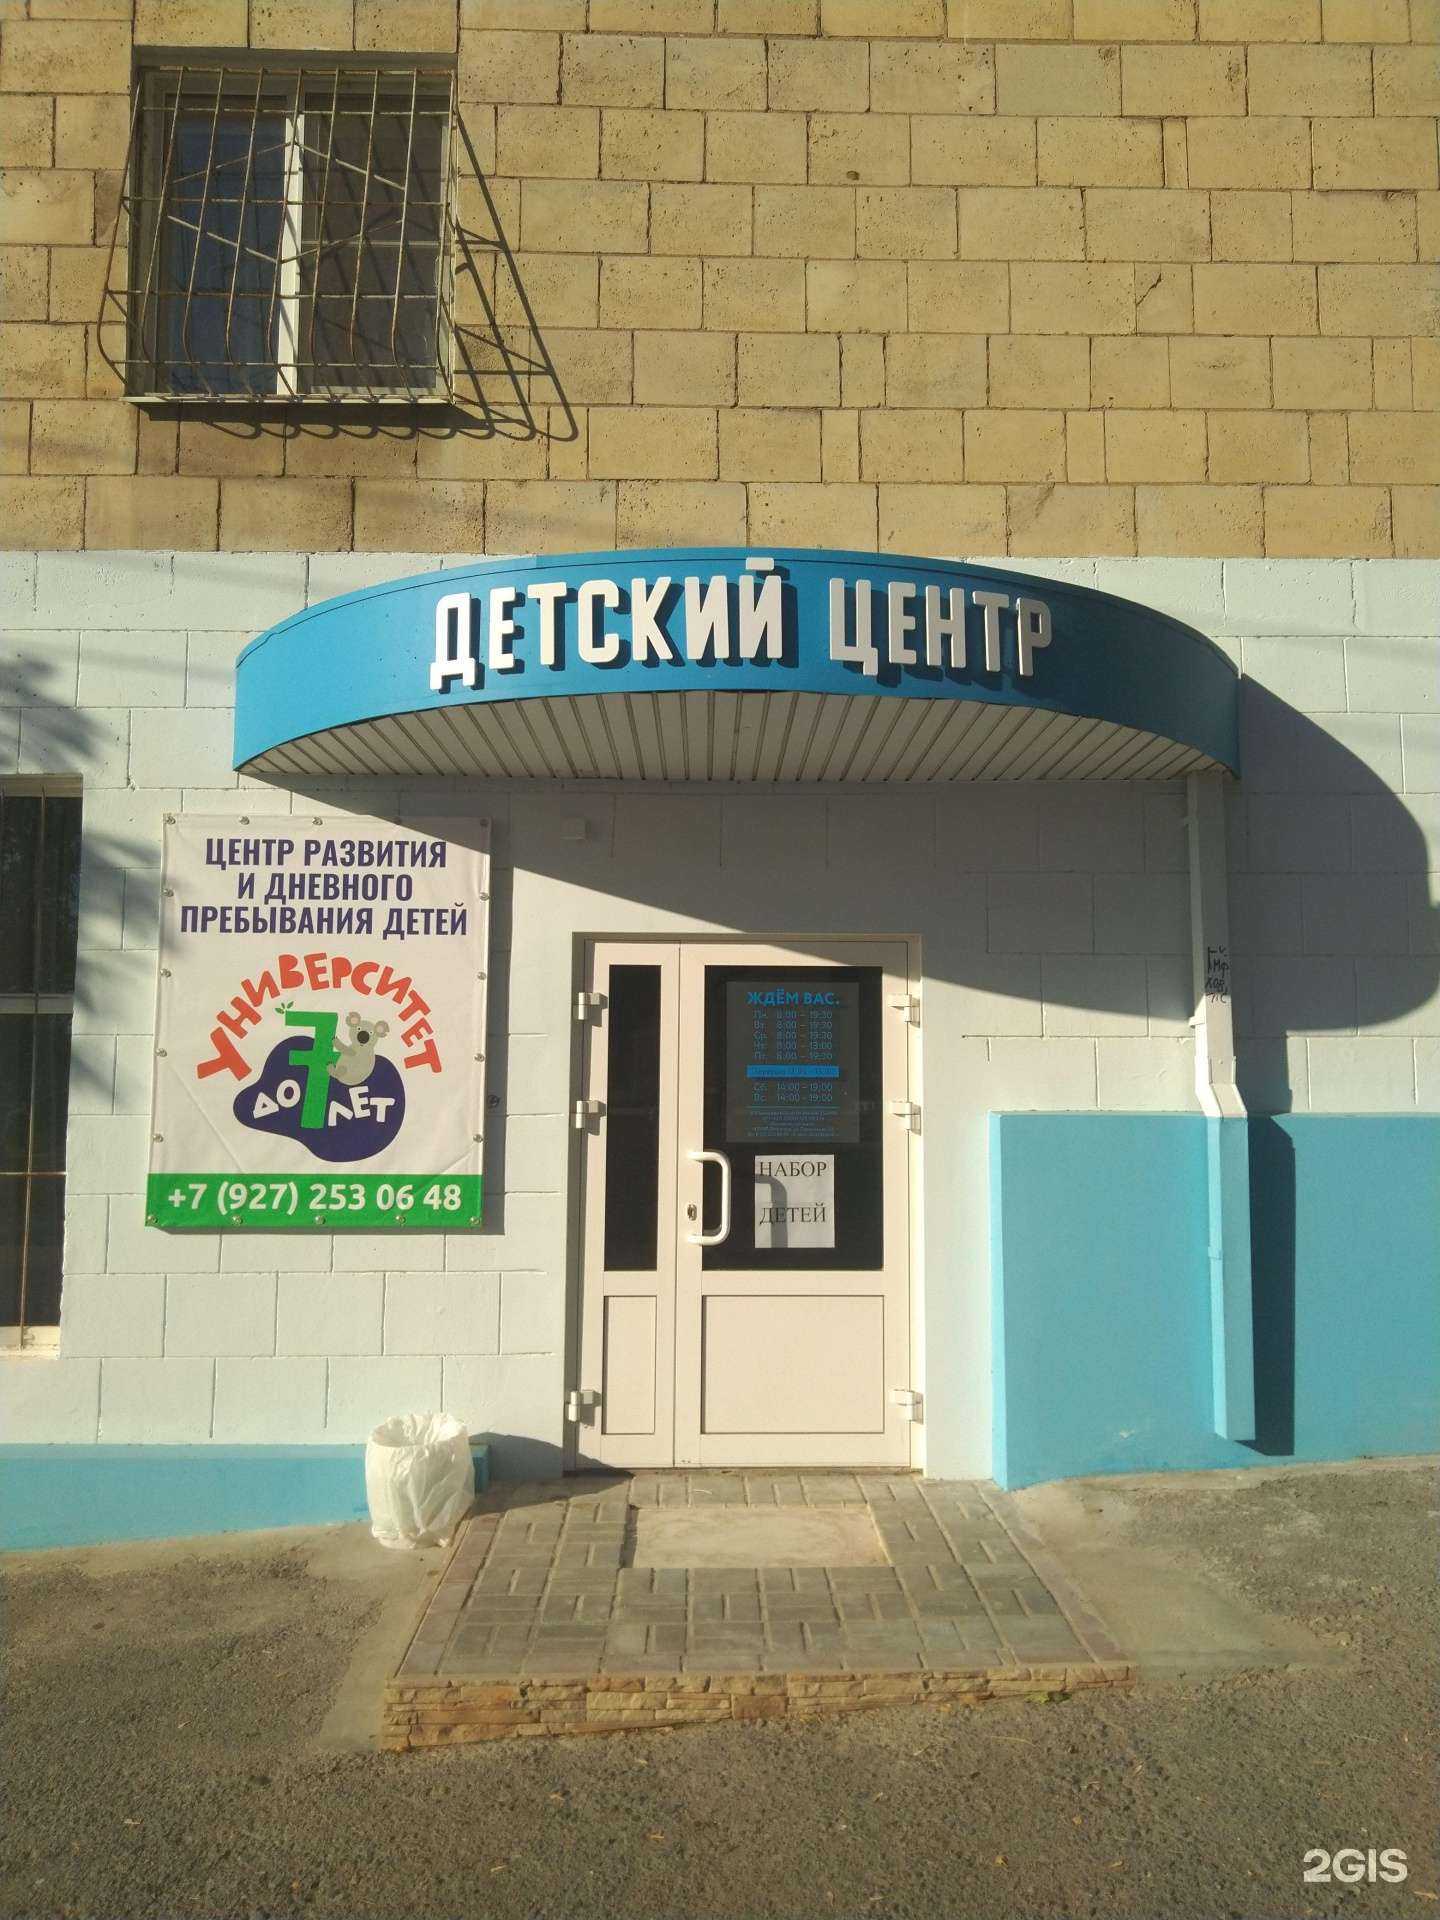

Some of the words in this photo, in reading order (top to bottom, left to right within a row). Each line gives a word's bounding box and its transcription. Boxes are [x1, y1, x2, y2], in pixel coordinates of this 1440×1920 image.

[429, 556, 783, 690] ДЕТСКИЙ
[829, 577, 1053, 677] ЦЕНТР
[205, 838, 295, 871] ЦЕНТР
[304, 839, 447, 868] РАЗВИТИЯ
[237, 872, 255, 900] И
[263, 872, 413, 906] ДНЕВНОГО
[180, 905, 373, 936] ПРЕБЫВАНИЯ
[382, 902, 468, 941] ДЕТЕЙ
[747, 988, 799, 1006] ЖДЁМ
[196, 951, 443, 1082] УНИВЕРСИТЕТ
[252, 1079, 301, 1119] ДО
[284, 1010, 341, 1130] 7
[327, 1085, 396, 1127] ЛЕТ
[760, 1161, 827, 1177] НАБОР
[168, 1183, 207, 1210] +7
[217, 1181, 299, 1215] (927)
[309, 1183, 366, 1211] 253
[376, 1183, 415, 1211] 06
[422, 1184, 462, 1211] 48
[760, 1202, 827, 1225] ДЕТЕЙ
